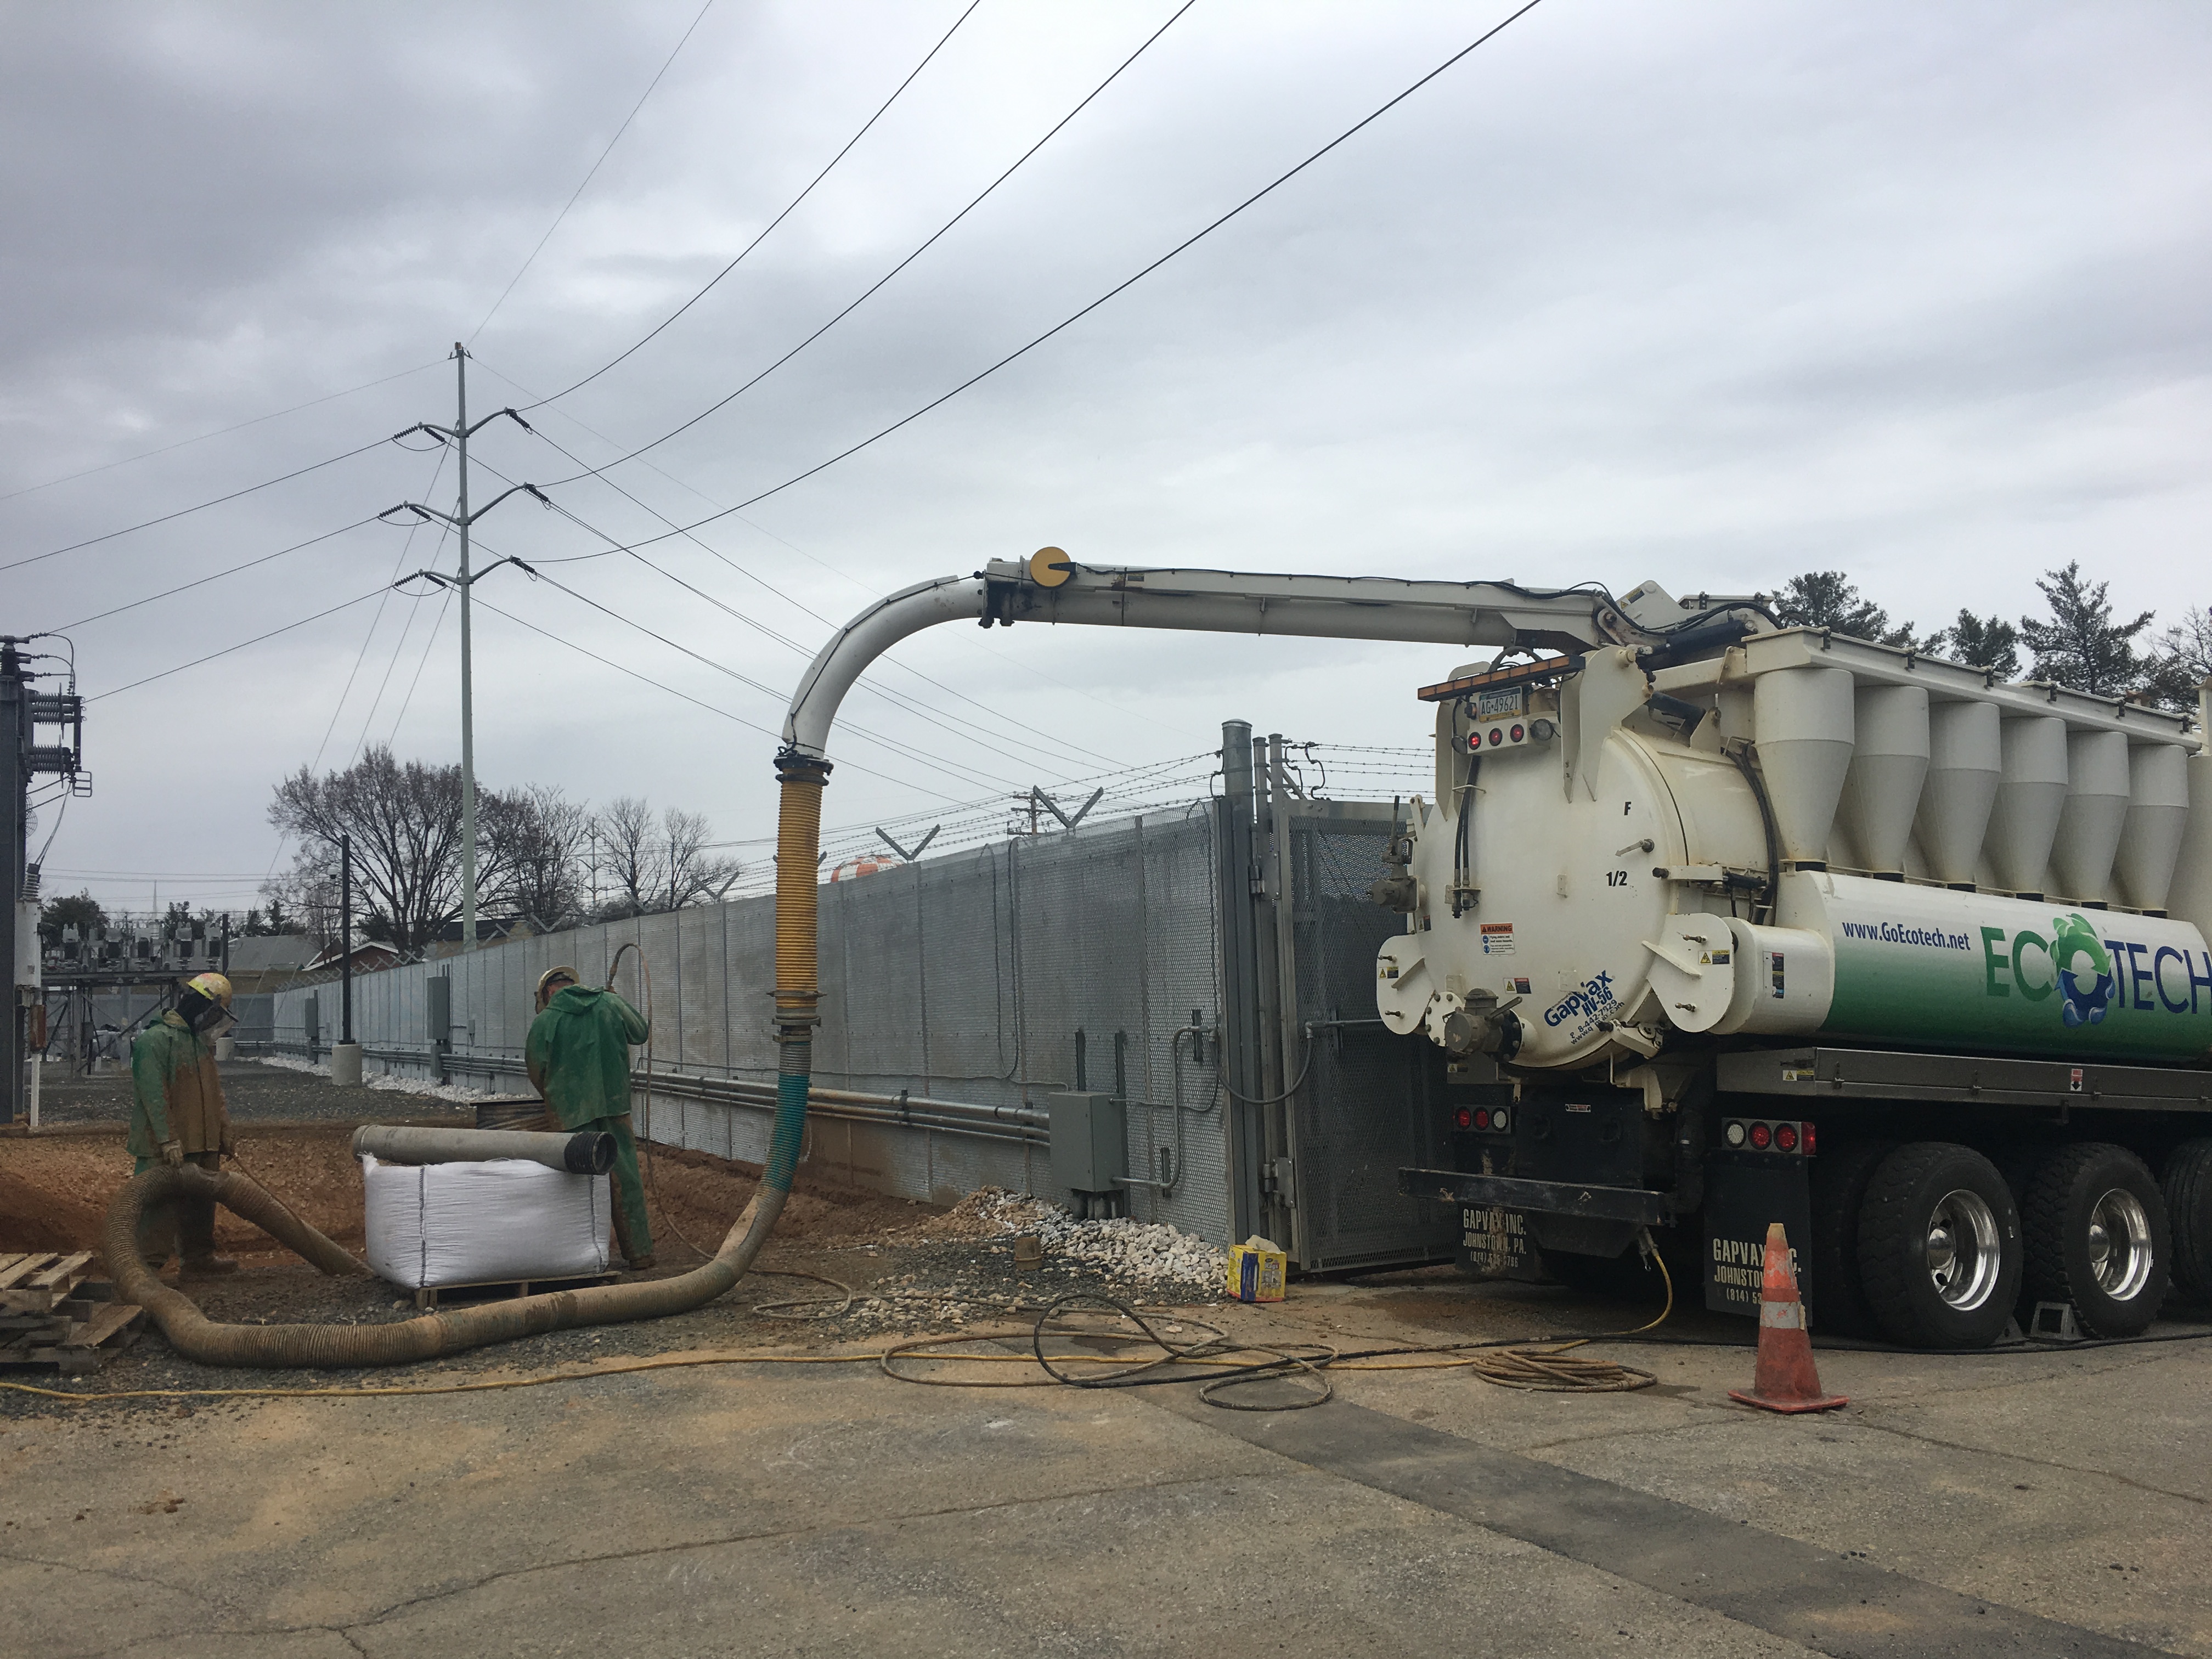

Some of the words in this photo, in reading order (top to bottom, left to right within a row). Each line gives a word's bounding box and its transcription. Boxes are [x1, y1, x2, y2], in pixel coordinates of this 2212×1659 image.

[1624, 802, 1632, 816] F
[1606, 871, 1628, 887] 1/2
[1842, 922, 1971, 951] www.GoEcotech.net
[1581, 986, 1613, 1018] HV-56
[1505, 1213, 1526, 1235] INC.
[1514, 1238, 1527, 1255] PA.
[1726, 1287, 1748, 1303] (814)
